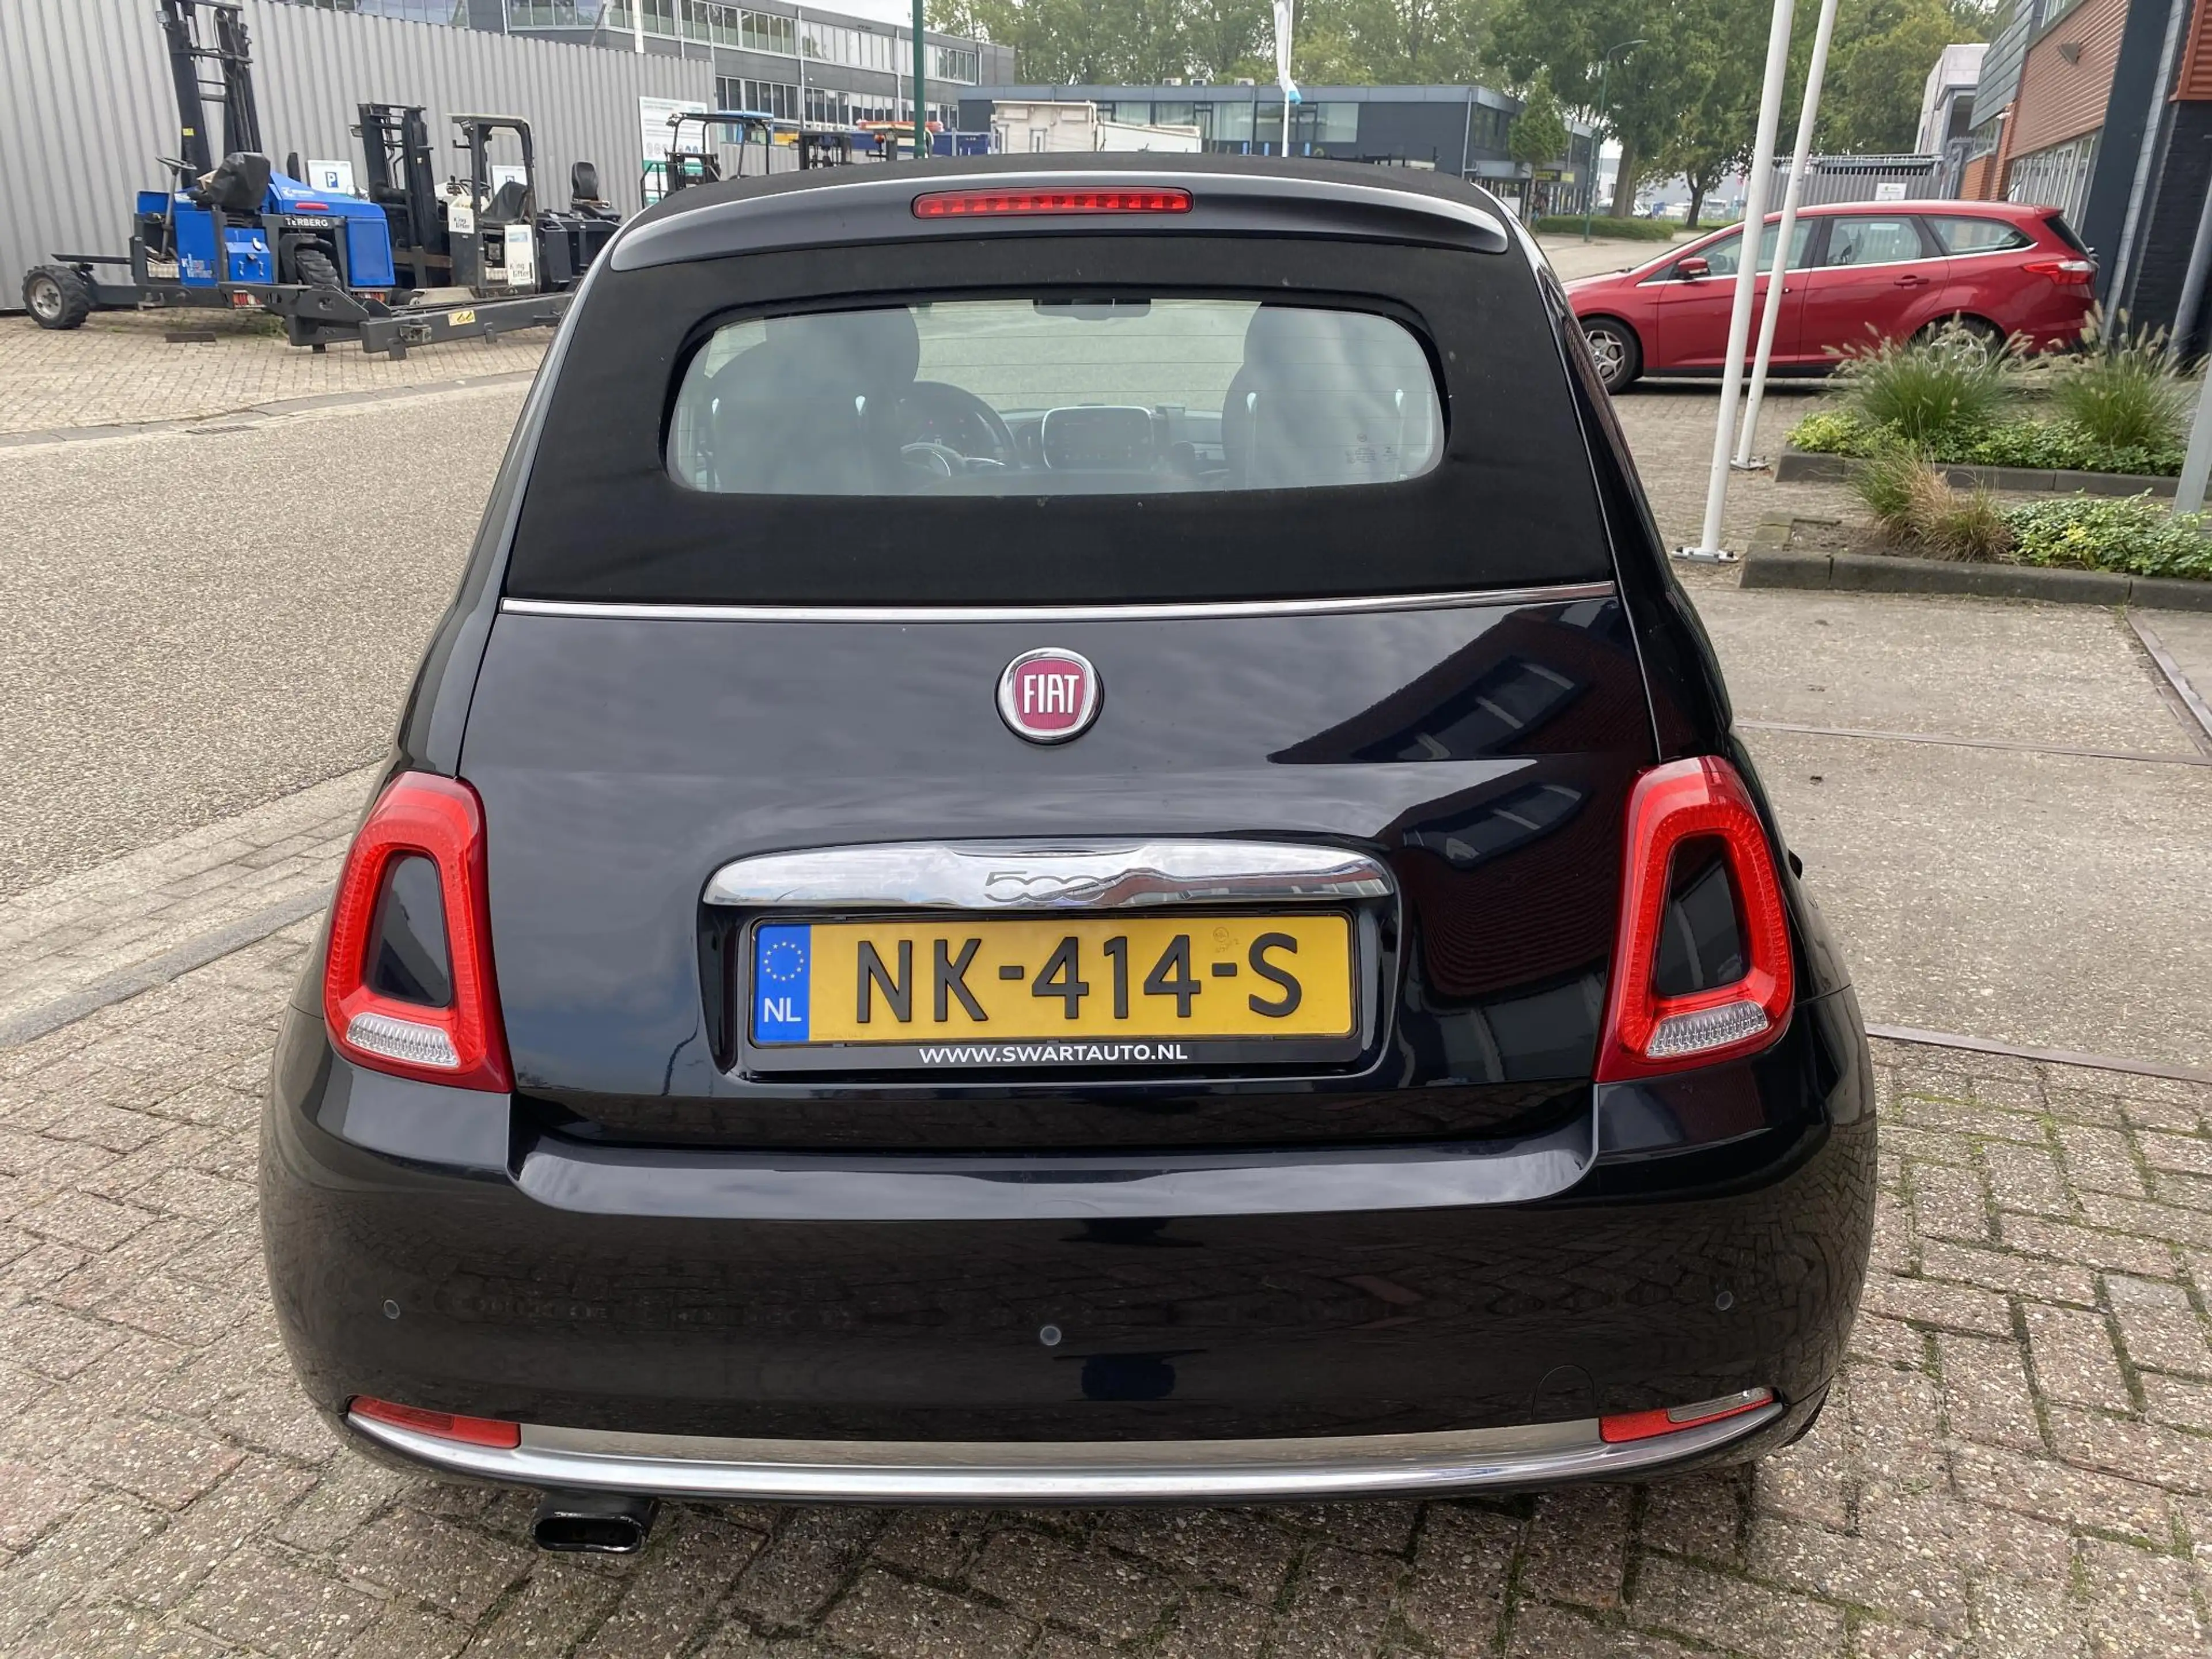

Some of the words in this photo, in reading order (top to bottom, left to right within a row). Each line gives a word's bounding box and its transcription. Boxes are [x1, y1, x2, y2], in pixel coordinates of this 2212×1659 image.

[327, 173, 336, 187] P
[285, 218, 328, 227] TERBERG
[1024, 674, 1080, 714] FIAT
[984, 870, 1105, 902] 500
[856, 931, 1302, 1024] NK-414-S
[763, 997, 802, 1023] NL
[919, 1044, 1188, 1063] WWW.SWARTAUTO.NL
